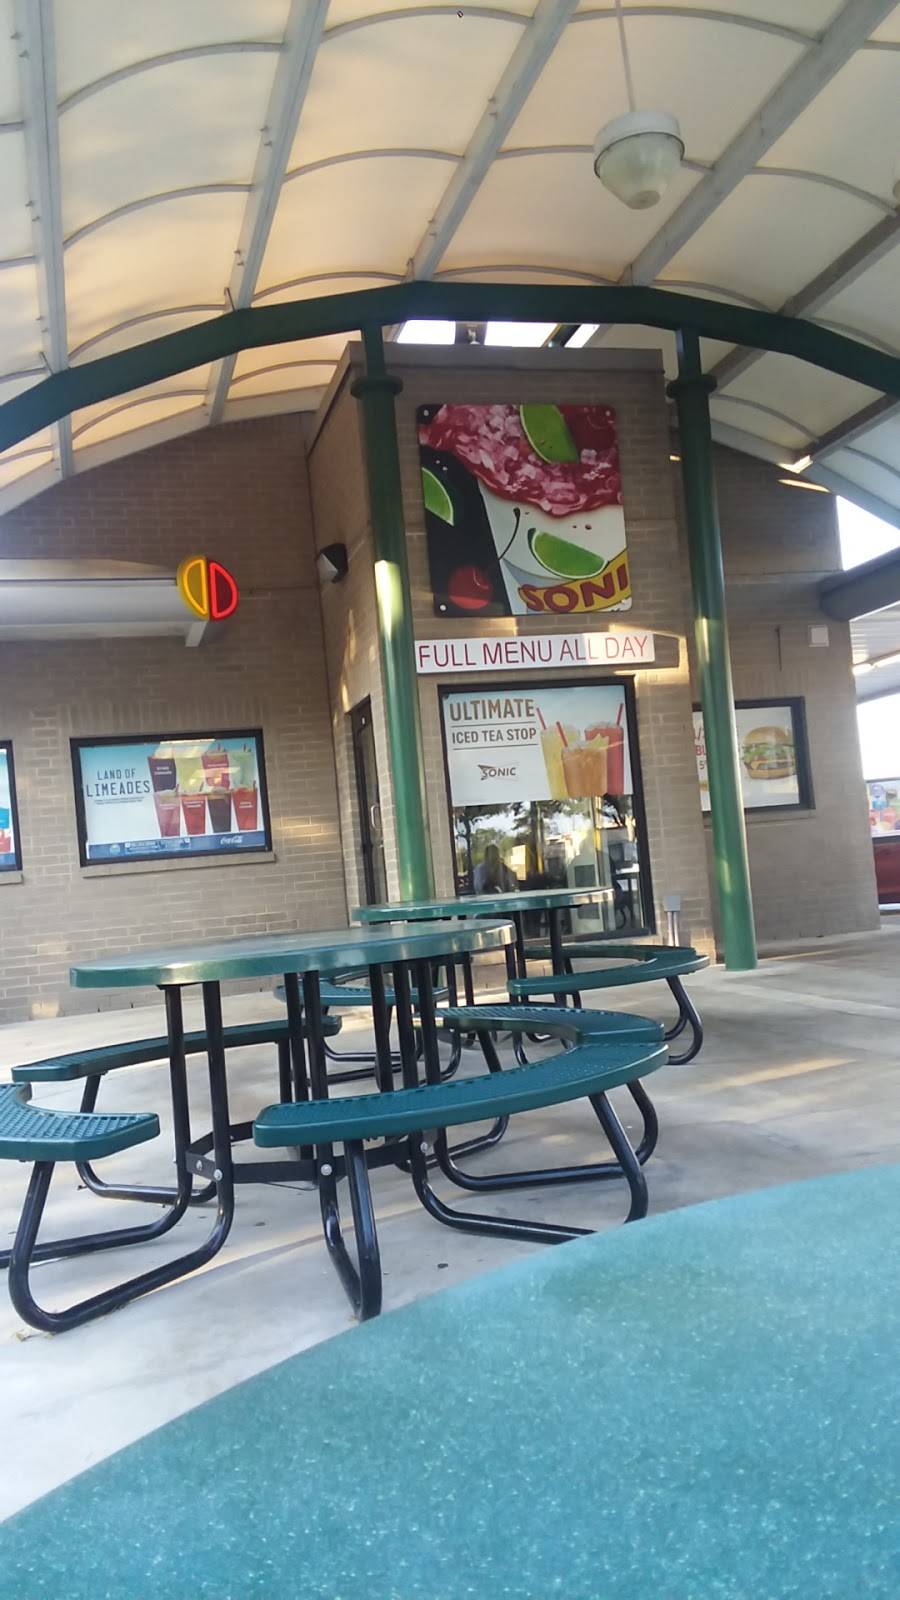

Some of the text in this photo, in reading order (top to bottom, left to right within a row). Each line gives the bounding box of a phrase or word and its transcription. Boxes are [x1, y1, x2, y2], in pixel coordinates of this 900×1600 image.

[518, 563, 629, 613] SONI
[418, 635, 648, 668] FULL MENU ALL DAY
[449, 698, 535, 722] ULTIMATE
[452, 727, 537, 744] ICED TEA STOP
[97, 767, 136, 781] LAND OF
[481, 766, 517, 778] SONIC
[86, 780, 151, 798] LIMEADES
